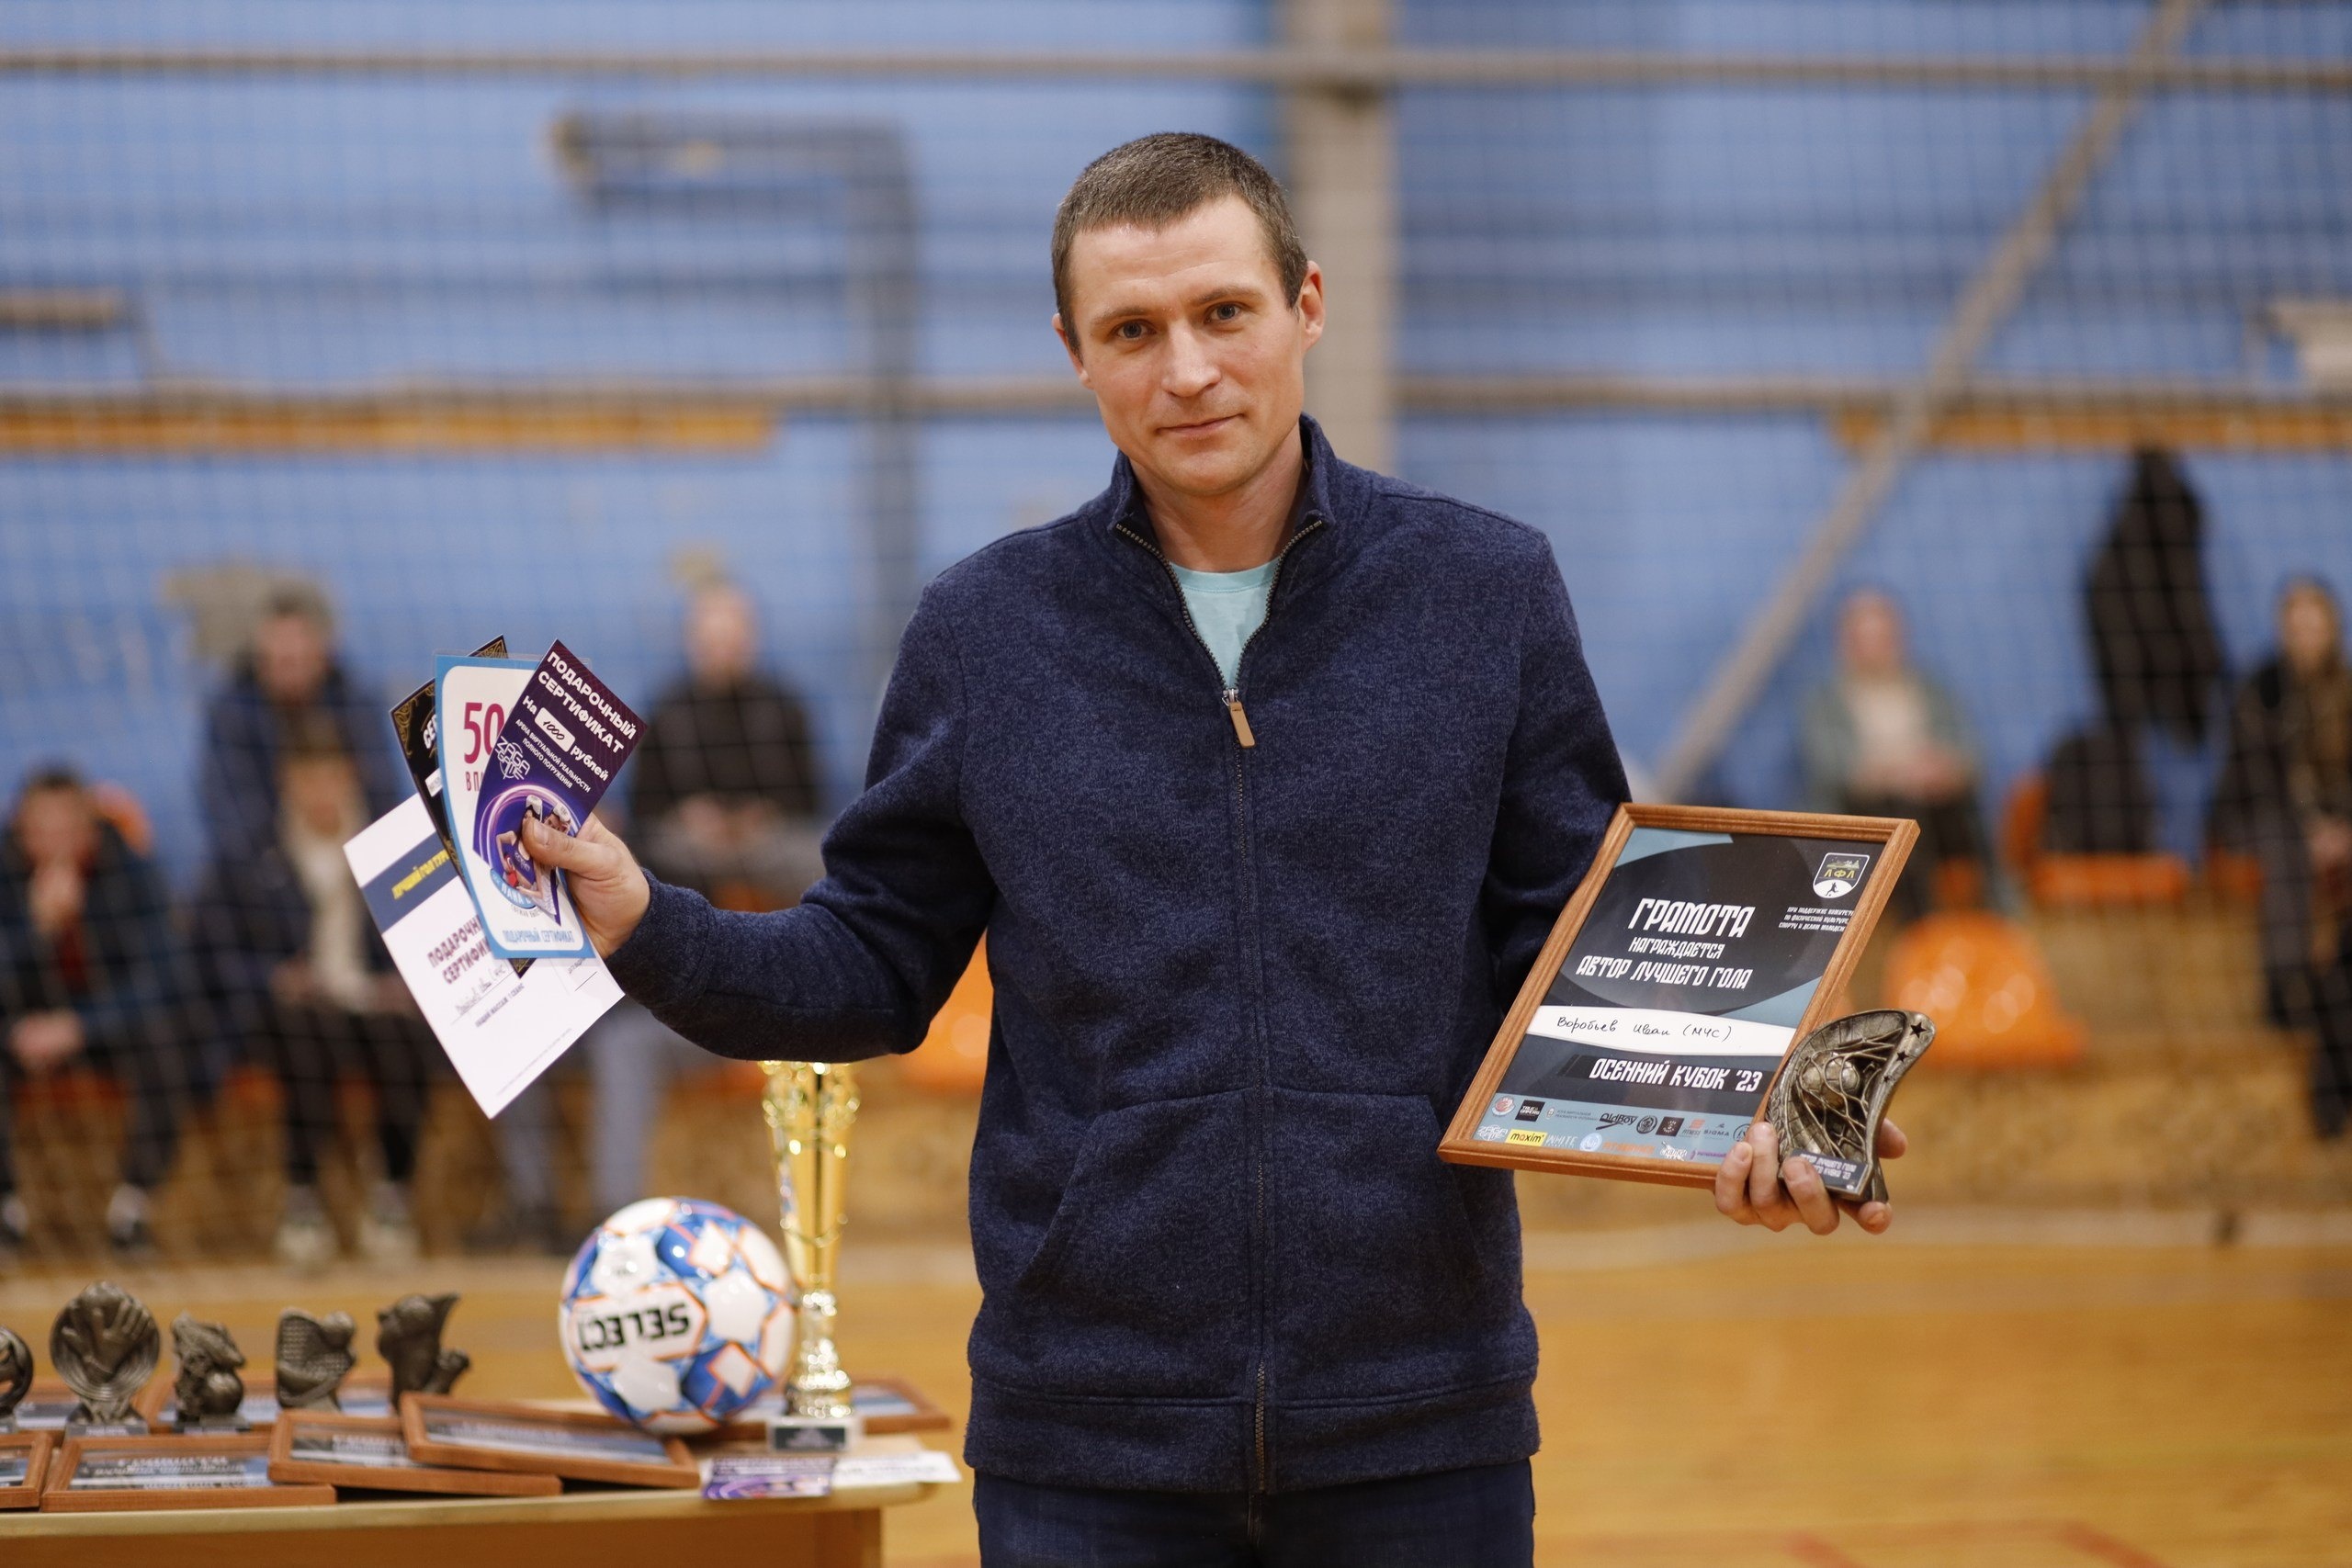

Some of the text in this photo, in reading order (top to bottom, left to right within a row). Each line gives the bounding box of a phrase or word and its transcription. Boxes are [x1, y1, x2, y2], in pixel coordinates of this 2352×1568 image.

[538, 671, 624, 753] СЕРТИФИКАТ
[547, 651, 637, 740] ПОДАРОЧНЫЙ
[515, 719, 592, 793] АРЕНА ВИРТУАЛЬНОЙ РЕАЛЬНОСТИ
[522, 695, 609, 782] На 1000 рублей
[522, 738, 572, 789] ПОЛНОГО ПОГРУЖЕНИЯ
[1627, 897, 1756, 938] ГРАМОТА
[1575, 955, 1753, 989] АВТОР ЛУЧШЕГО ГОЛА
[1627, 936, 1725, 959] НАГРАЖДАЕТСЯ
[1589, 1058, 1762, 1092] ОСЕННИЙ КУБОК '23
